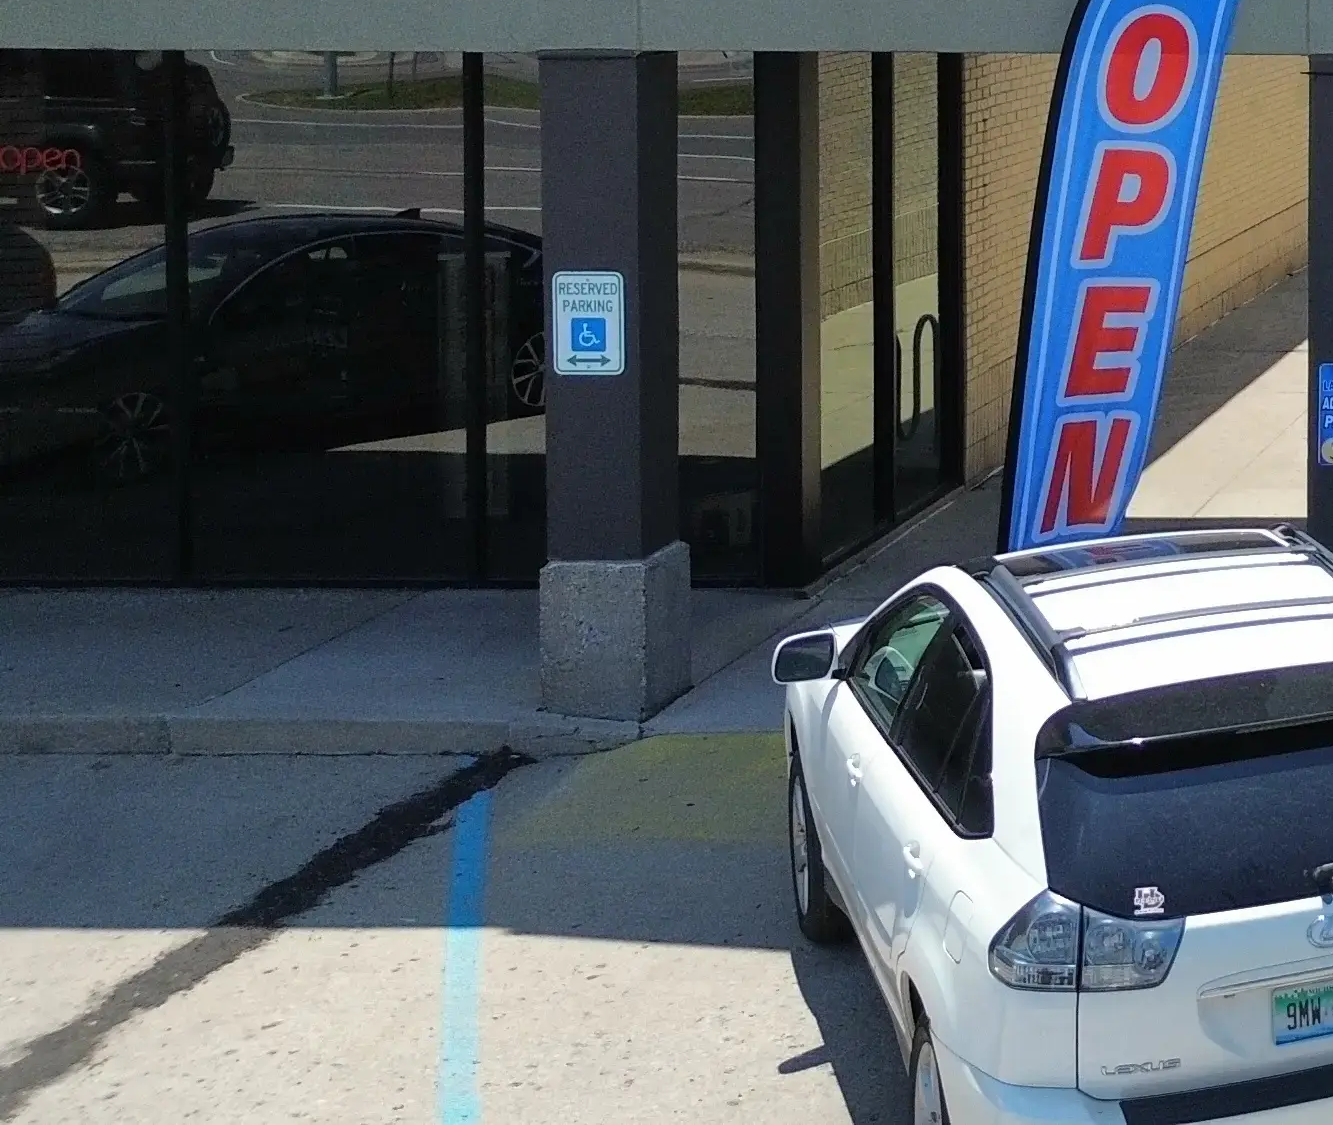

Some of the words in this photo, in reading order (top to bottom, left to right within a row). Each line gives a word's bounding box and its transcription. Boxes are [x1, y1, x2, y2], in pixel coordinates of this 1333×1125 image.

[0, 145, 81, 175] open
[1040, 13, 1190, 533] OPEN
[558, 282, 618, 295] RESERVED
[562, 299, 613, 312] PARKING
[1286, 996, 1321, 1031] 9MW
[1100, 1057, 1182, 1076] LEXUS
